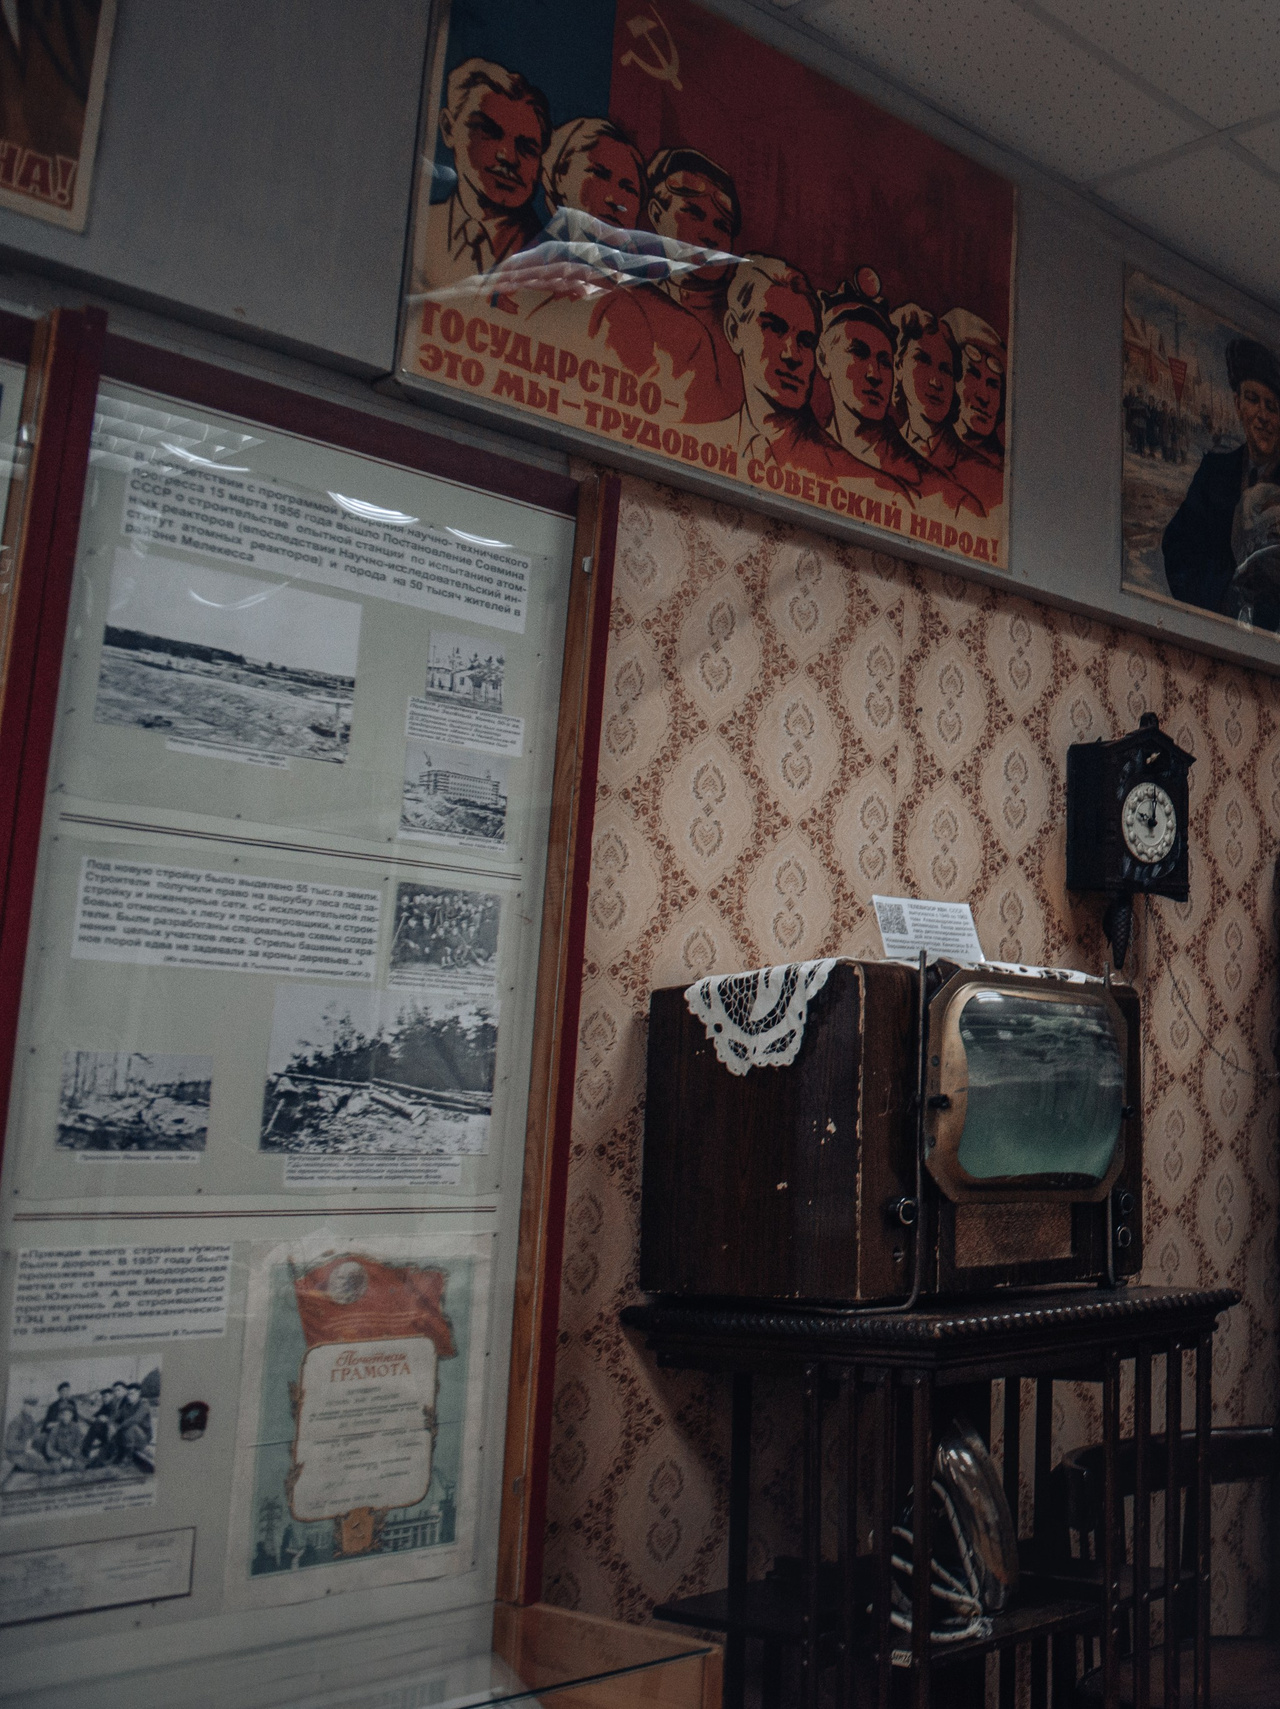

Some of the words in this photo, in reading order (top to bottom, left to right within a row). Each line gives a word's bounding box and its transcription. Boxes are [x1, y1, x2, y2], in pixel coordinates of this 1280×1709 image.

[331, 363, 411, 382] ГРАМОТА
[421, 301, 679, 415] ГОСУДАРСТВО-
[419, 343, 484, 387] ЭТО
[747, 458, 901, 530] СОВЕТСКИЙ
[910, 512, 999, 563] НАРОД!
[134, 451, 145, 461] В
[247, 485, 255, 493] с
[259, 488, 338, 515] программой
[340, 509, 403, 536] ускорения
[407, 529, 452, 546] научно-
[456, 543, 529, 569] технического
[130, 479, 172, 497] СССР
[175, 494, 184, 502] о
[188, 497, 288, 529] строительстве
[296, 525, 352, 545] опытной
[355, 541, 404, 559] станции
[411, 555, 424, 565] по
[429, 561, 493, 584] испытанию
[496, 579, 526, 592] атом-
[181, 535, 254, 562] Мелекесса
[210, 486, 225, 499] 15
[228, 493, 267, 510] марта
[273, 504, 300, 518] 1956
[304, 514, 332, 527] года
[336, 522, 379, 540] вышло
[383, 533, 472, 565] Постановление
[475, 559, 525, 581] Совмина
[162, 504, 234, 529] реакторов
[239, 523, 335, 554] (впоследствии
[339, 548, 501, 598] Научно-исследовательский
[504, 594, 521, 603] ин-
[182, 524, 242, 544] атомных
[250, 541, 322, 566] реакторов)
[344, 565, 386, 581] города
[393, 578, 406, 586] на
[410, 580, 423, 590] 50
[427, 586, 461, 600] тысяч
[465, 597, 511, 613] жителей
[85, 871, 150, 887] Строители
[157, 881, 212, 894] получили
[216, 888, 248, 898] право
[267, 894, 313, 906] вырубку
[343, 902, 361, 910] под
[87, 859, 111, 871] Под
[114, 865, 152, 876] новую
[156, 869, 201, 882] стройку
[205, 873, 235, 884] было
[239, 879, 292, 891] выделено
[296, 884, 308, 893] 55
[83, 896, 123, 908] бовью
[127, 903, 187, 915] отнеслись
[200, 910, 226, 921] лесу
[344, 925, 376, 934] строи-
[84, 886, 131, 899] стройку
[146, 893, 218, 906] инженерные
[269, 906, 357, 920] исключительной
[116, 911, 150, 923] Были
[153, 917, 229, 931] разработаны
[232, 926, 305, 938] специальные
[308, 933, 341, 942] схемы
[344, 936, 377, 945] сохра-
[123, 927, 161, 936] целых
[165, 931, 216, 942] участков
[254, 937, 296, 949] Стрелы
[298, 941, 352, 954] башенных
[355, 948, 375, 957] кра-
[104, 937, 142, 947] порой
[145, 941, 172, 950] едва
[193, 945, 244, 955] задевали
[262, 951, 296, 960] кроны
[19, 1261, 58, 1269] были
[133, 1256, 160, 1264] 1957
[195, 1254, 229, 1262] была
[89, 1248, 125, 1256] всего
[134, 1246, 184, 1255] стройке
[19, 1271, 94, 1280] проложена
[110, 1266, 227, 1276] железнодорожная
[82, 1280, 137, 1288] станции
[15, 1303, 105, 1314] протянулись
[137, 1296, 222, 1307] строившихся
[128, 1289, 172, 1297] вскоре
[175, 1286, 224, 1294] рельсы
[16, 1315, 44, 1324] ТЭЦ
[68, 1307, 222, 1322] ремонтно-механическо-
